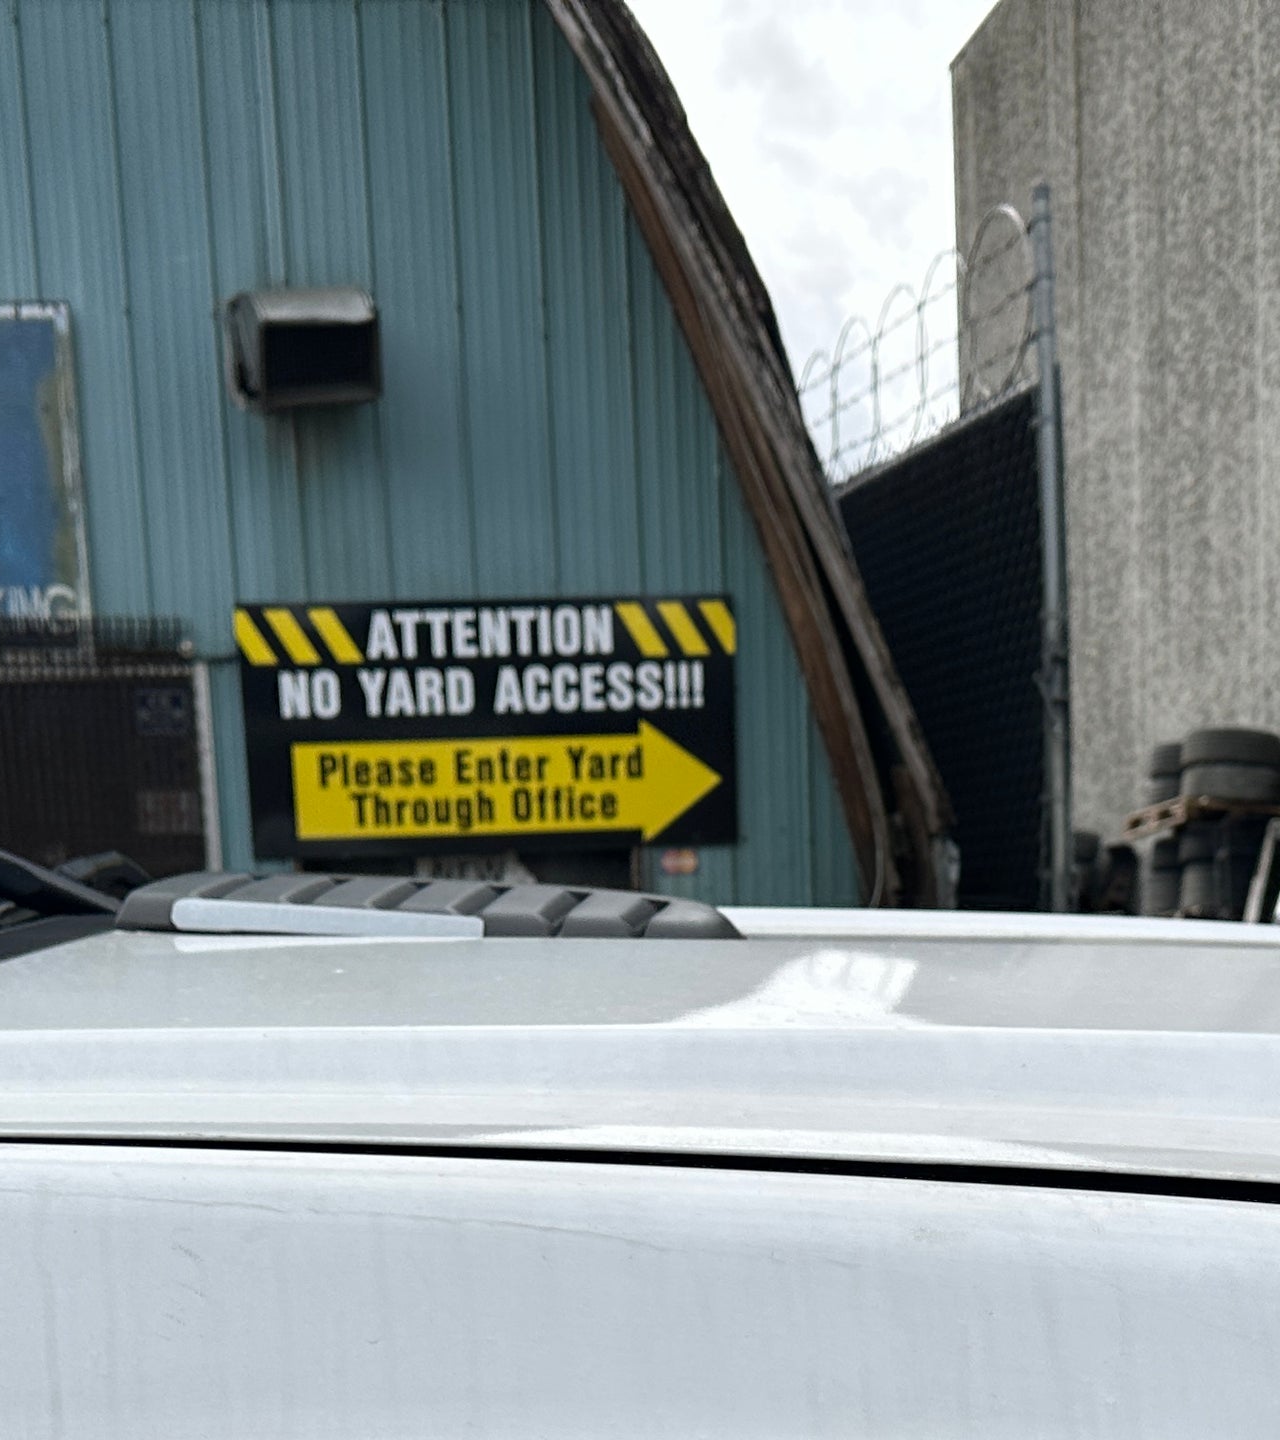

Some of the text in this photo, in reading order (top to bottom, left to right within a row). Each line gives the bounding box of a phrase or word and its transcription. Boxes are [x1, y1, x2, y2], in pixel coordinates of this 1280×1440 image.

[366, 605, 615, 661] ATTENTION
[277, 660, 706, 720] NO YARD ACCESS!!!
[318, 744, 644, 790] Please Enter Yard
[351, 785, 618, 830] Through Office
